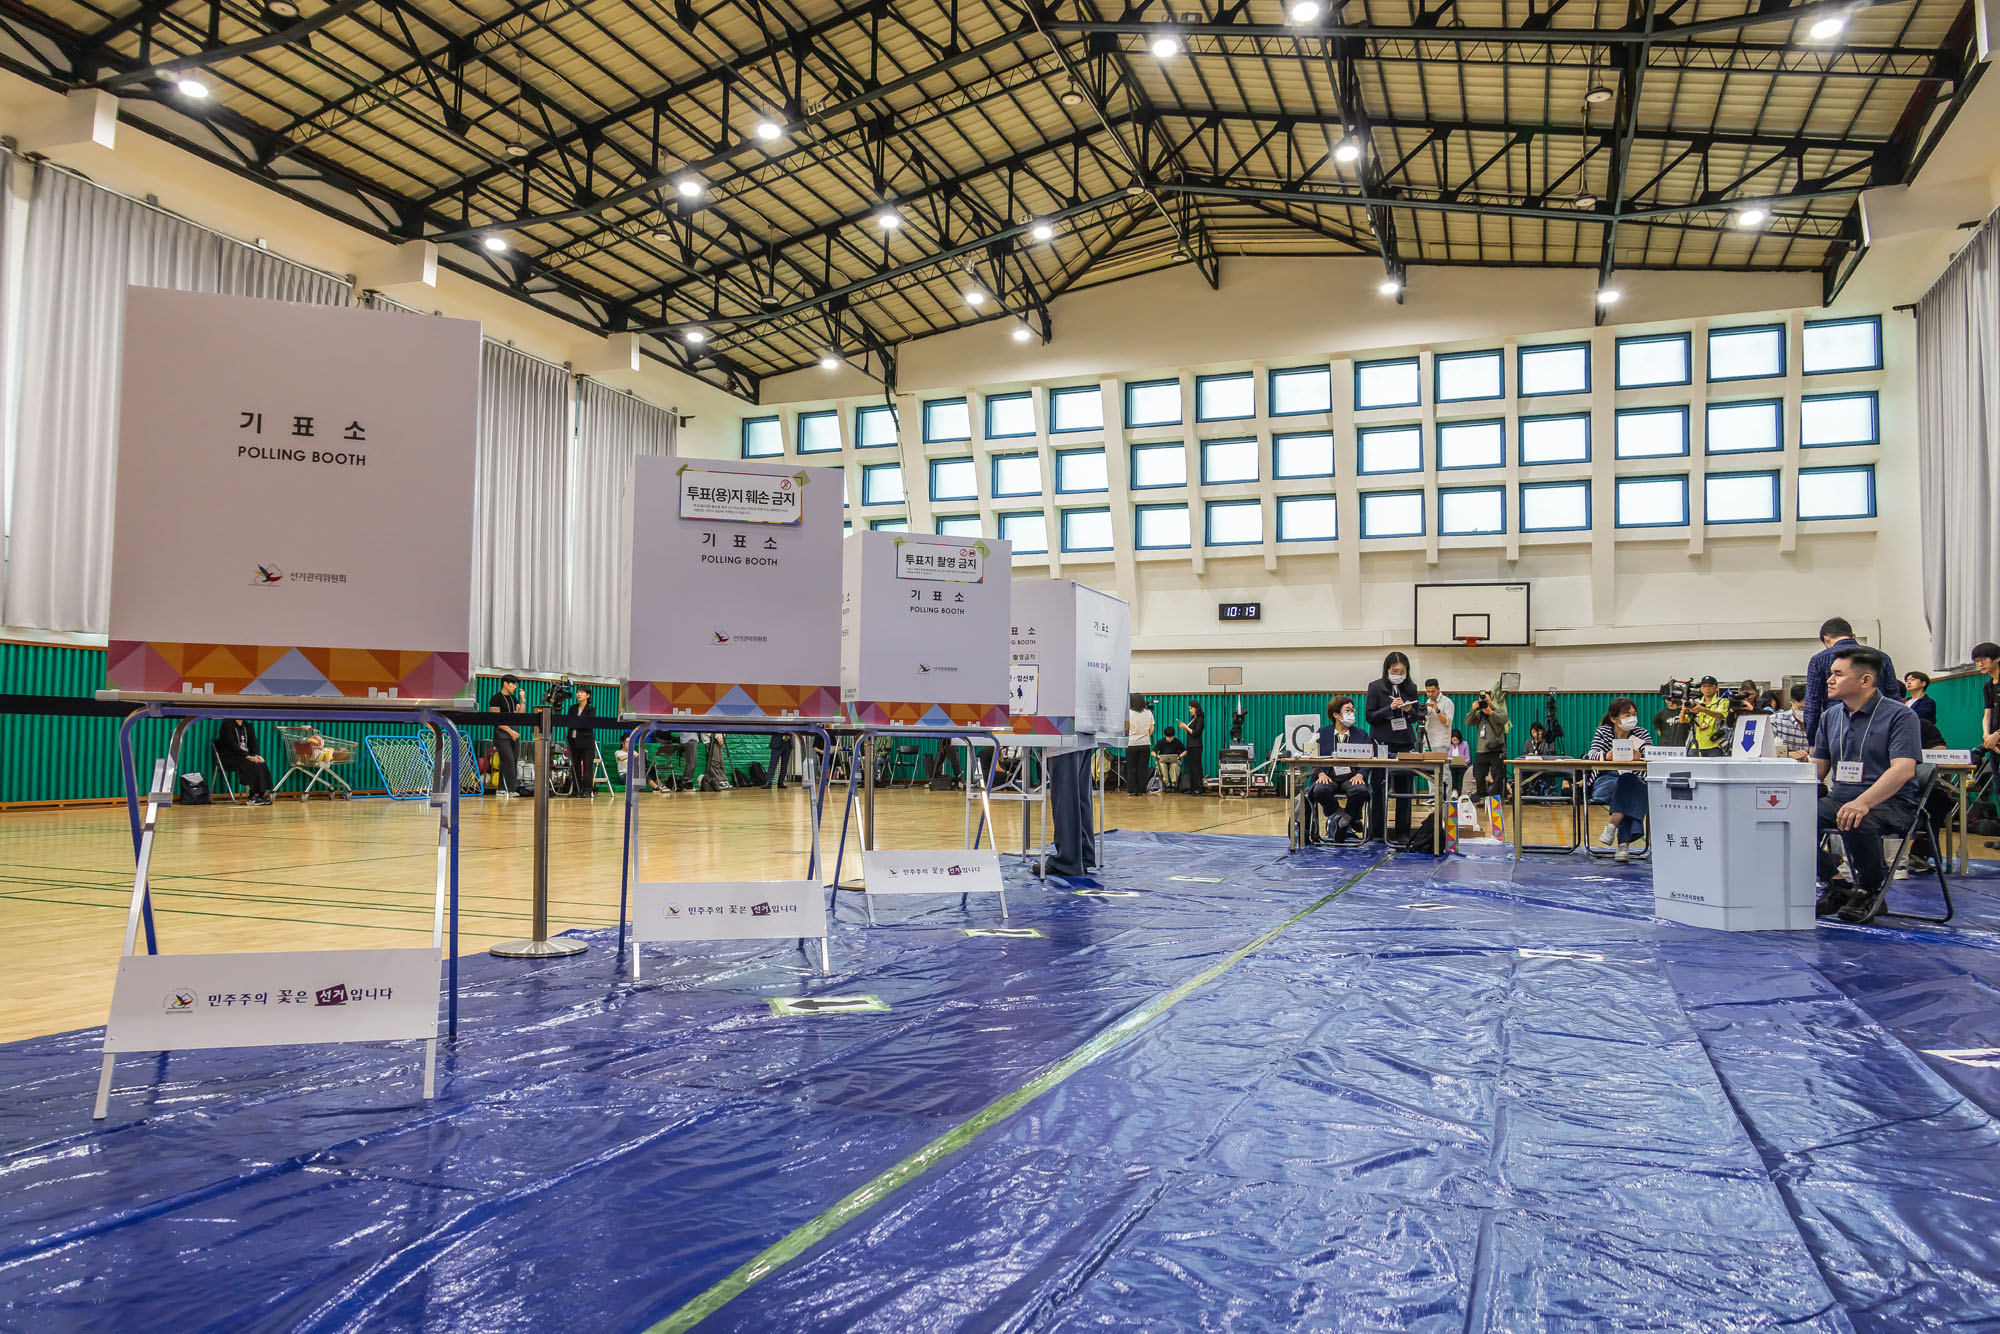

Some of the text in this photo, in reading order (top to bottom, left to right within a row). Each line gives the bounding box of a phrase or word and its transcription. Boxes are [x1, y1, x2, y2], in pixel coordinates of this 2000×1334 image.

[237, 445, 366, 467] POLLING BOOTH
[686, 486, 795, 507] 투표(용)지 훼손 금지
[701, 554, 778, 567] POLLING BOOTH
[905, 554, 977, 570] 투표지 촬영 금지
[289, 572, 347, 584] 선거관리위원회
[910, 606, 965, 615] POLLING BOOTH
[1226, 606, 1256, 617] 10:19
[687, 905, 723, 916] 민주주의
[728, 904, 748, 915] 꽃은
[208, 991, 268, 1007] 민주주의
[276, 989, 309, 1004] 꽃은
